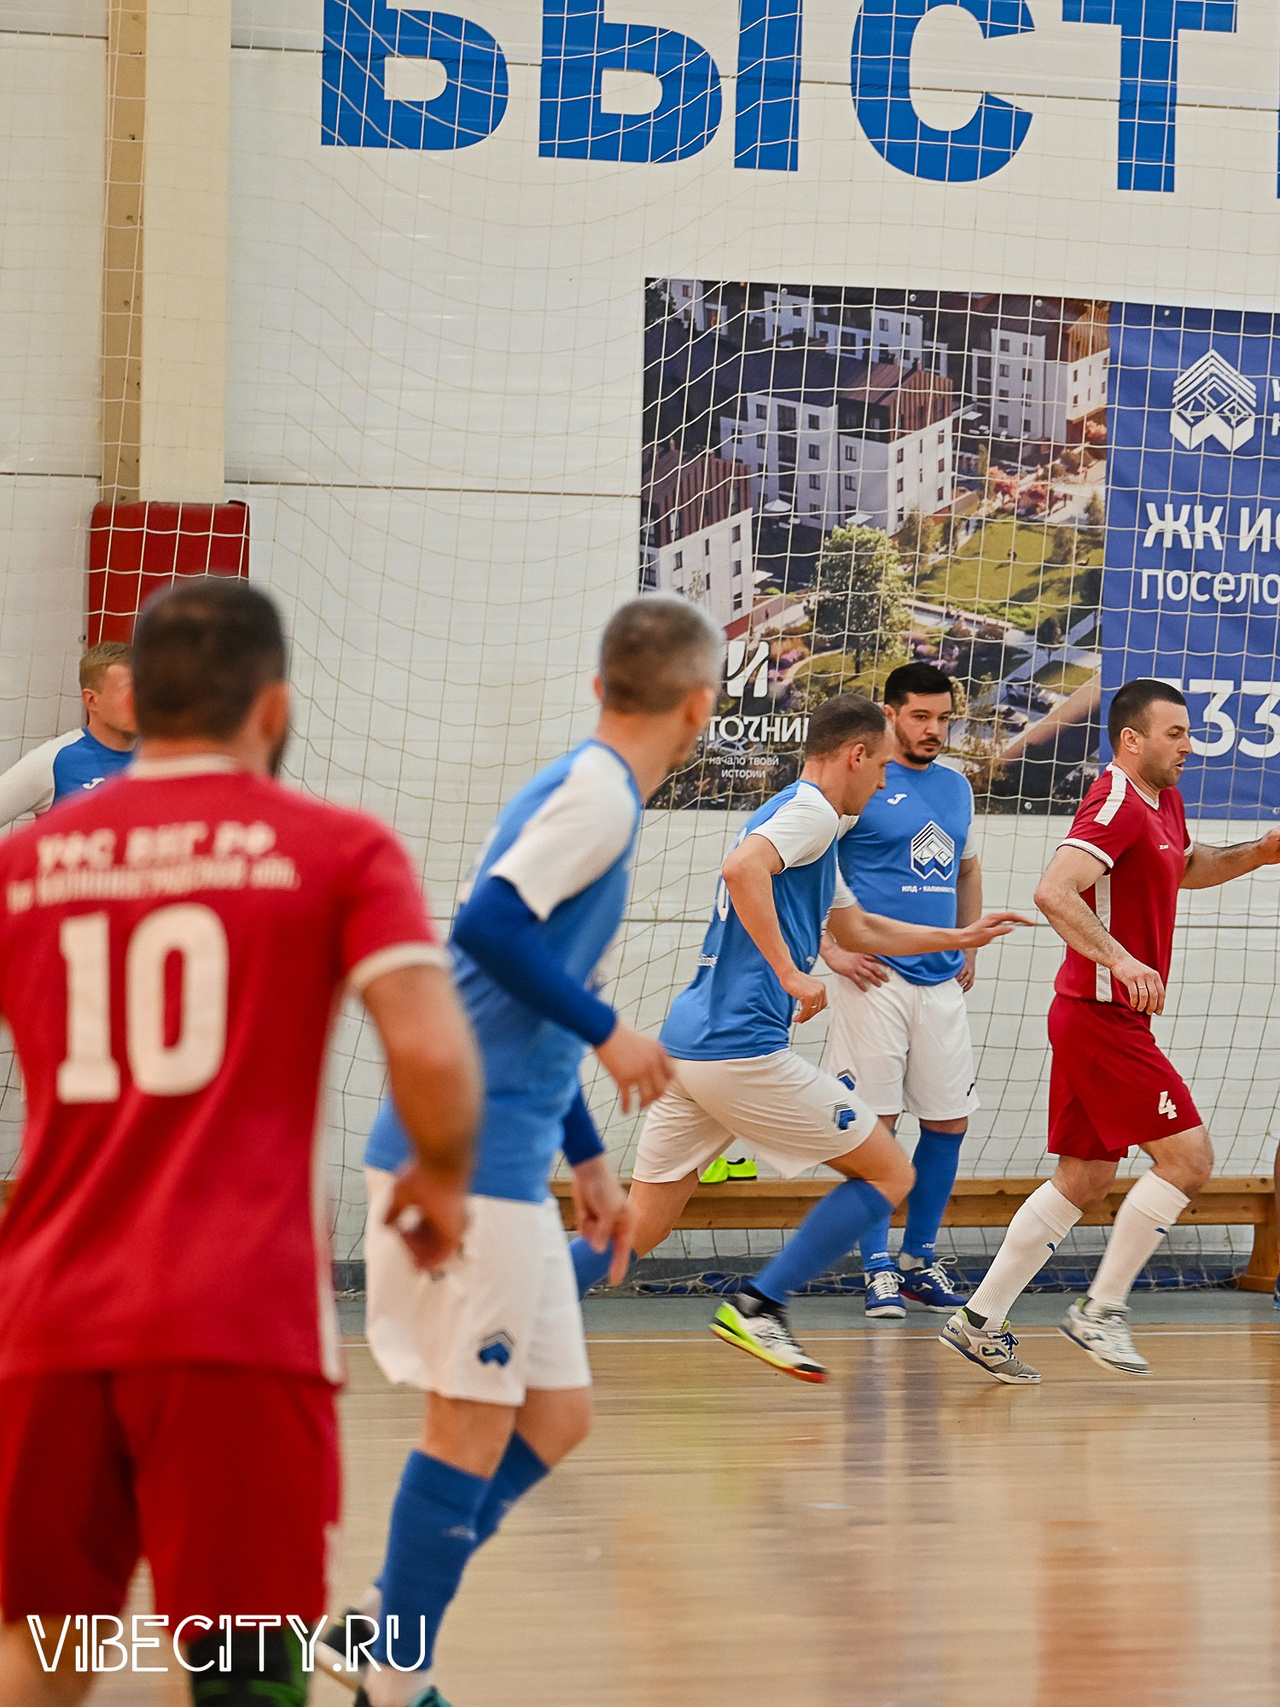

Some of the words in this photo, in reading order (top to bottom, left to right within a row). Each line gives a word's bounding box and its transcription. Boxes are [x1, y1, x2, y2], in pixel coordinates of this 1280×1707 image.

[1143, 503, 1224, 551] ЖК
[708, 756, 746, 766] начало
[750, 755, 779, 766] твоей
[721, 769, 766, 779] истории
[56, 902, 230, 1104] 10
[1158, 1091, 1178, 1120] 4
